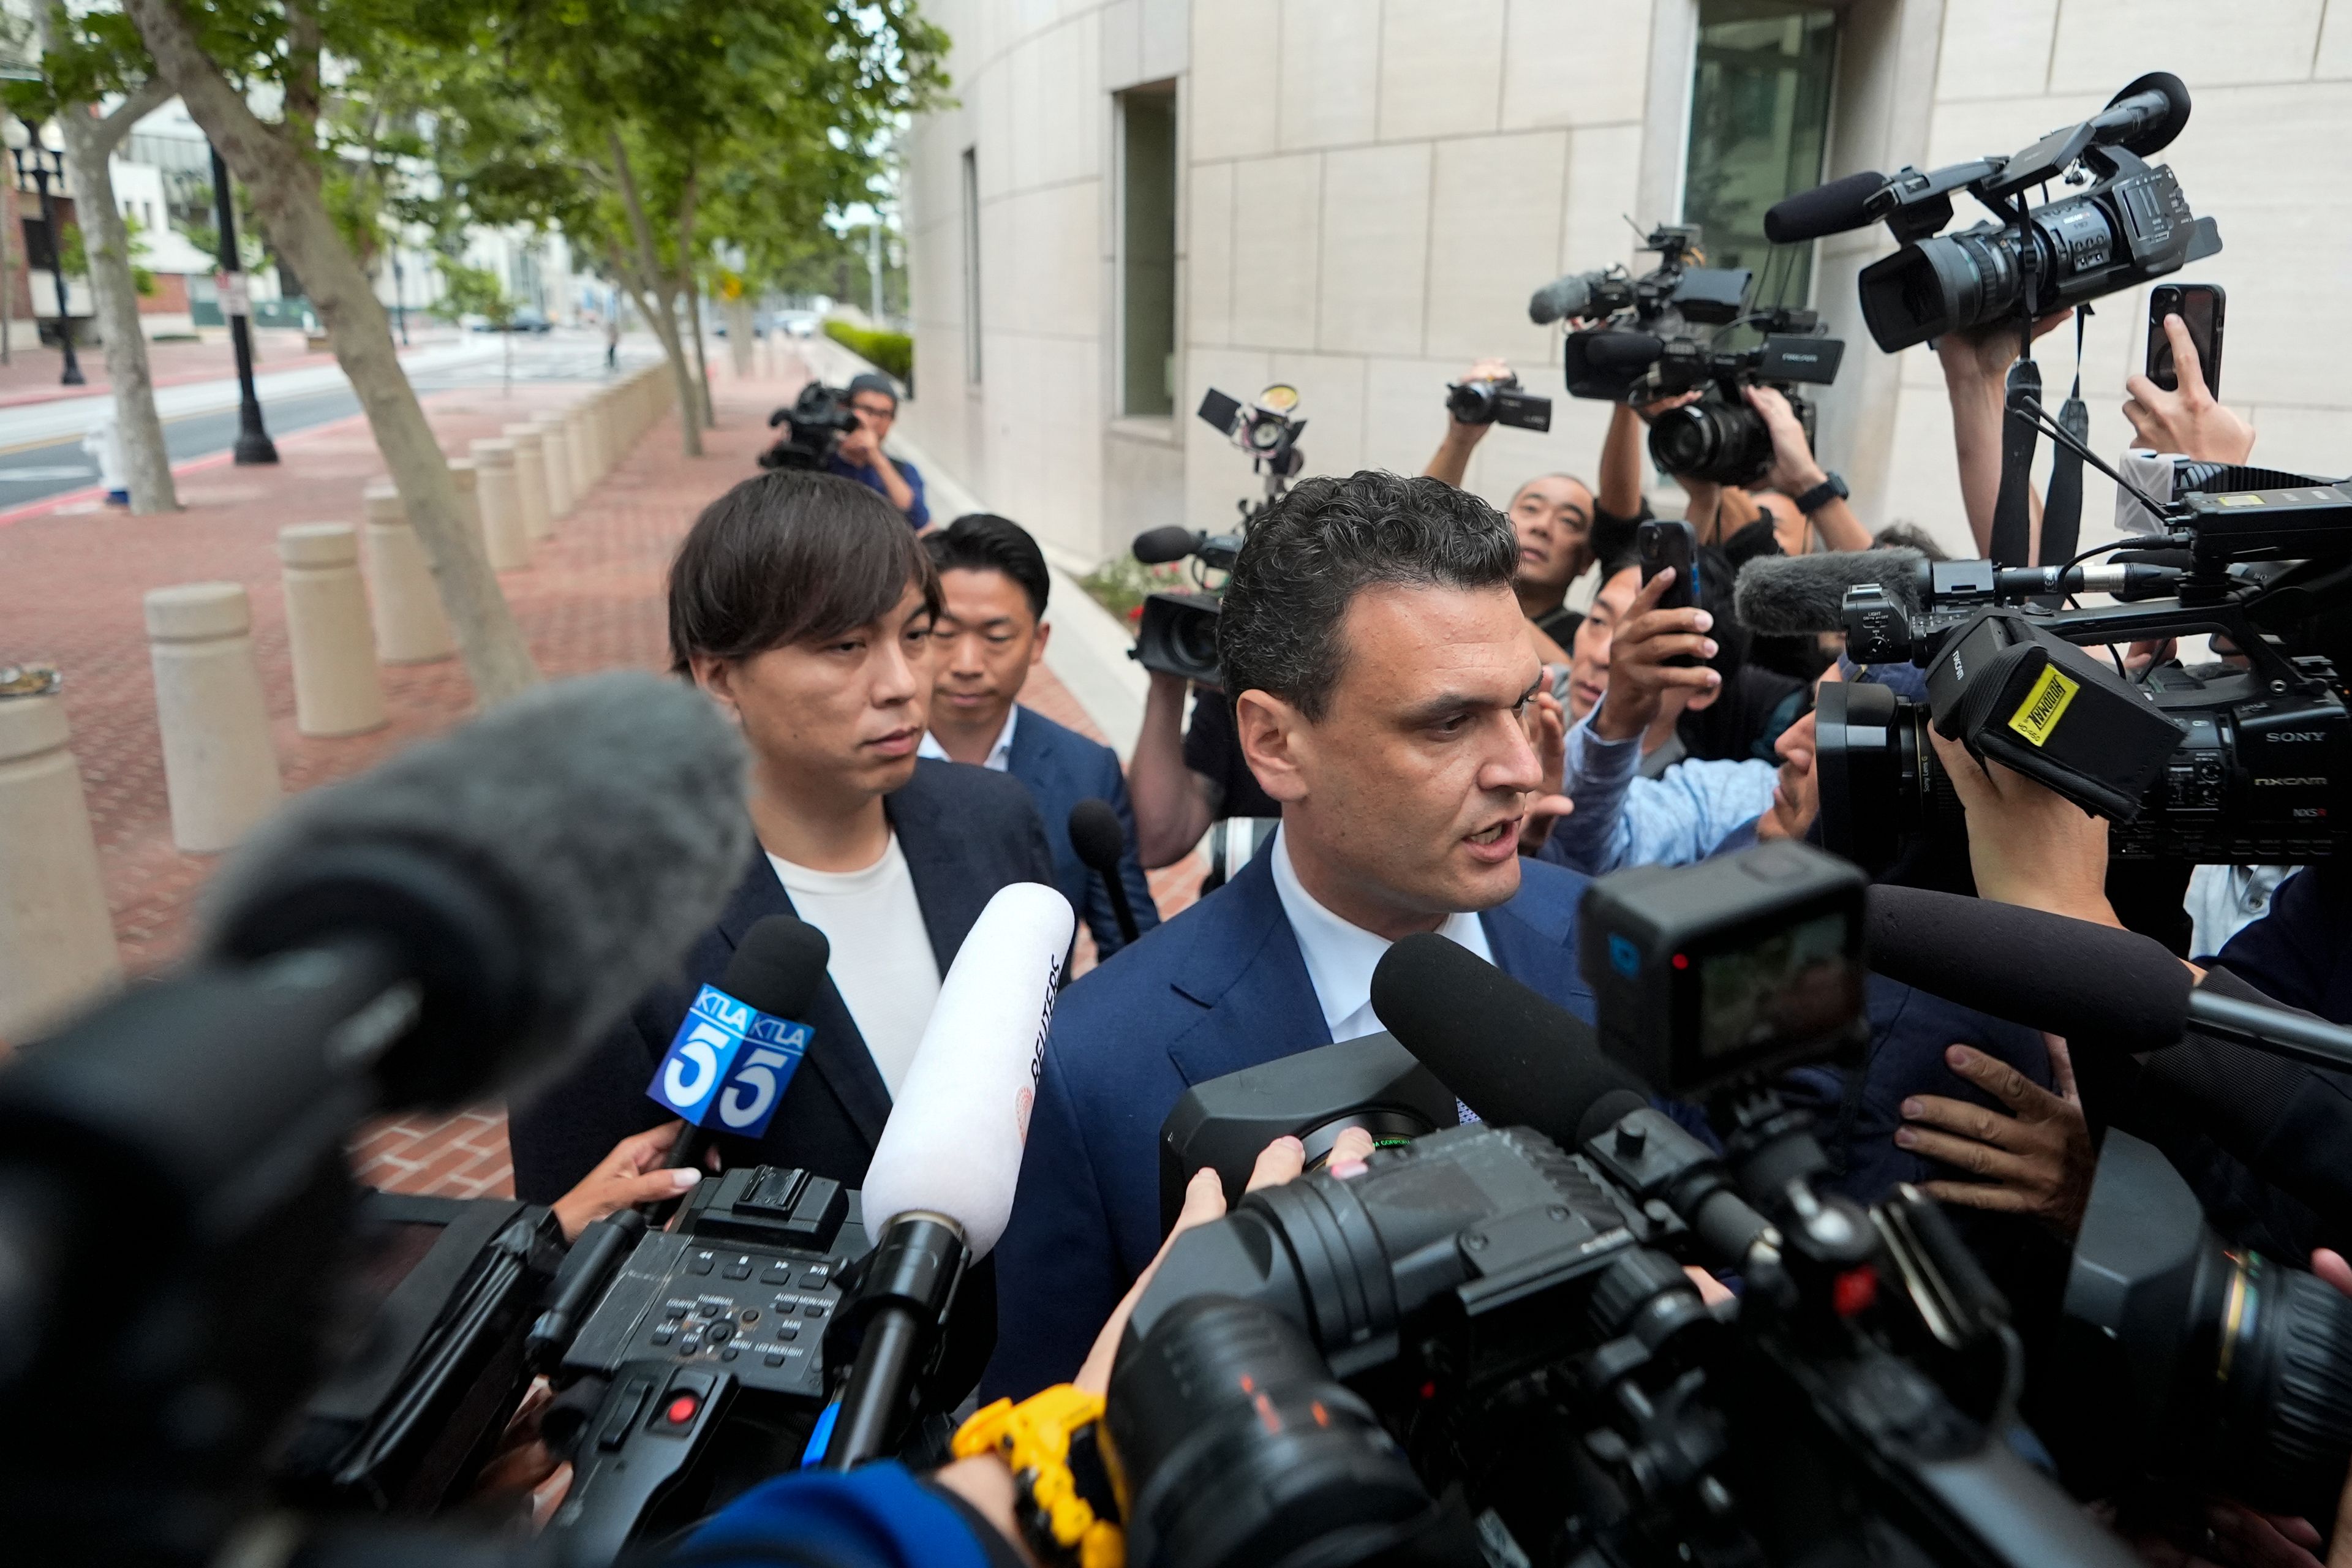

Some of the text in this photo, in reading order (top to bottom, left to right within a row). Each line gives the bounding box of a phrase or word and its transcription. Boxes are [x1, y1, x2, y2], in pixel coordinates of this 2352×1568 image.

[2027, 674, 2066, 731] HOODMAN
[2266, 732, 2326, 742] SONY
[694, 988, 748, 1032] KTLA
[1031, 953, 1060, 1089] REUTERS
[749, 1017, 805, 1049] KTLA
[664, 1022, 731, 1107] 5
[719, 1048, 788, 1128] 5
[774, 1292, 835, 1308] AUDIO MON/ADV
[728, 1338, 753, 1350] MENU
